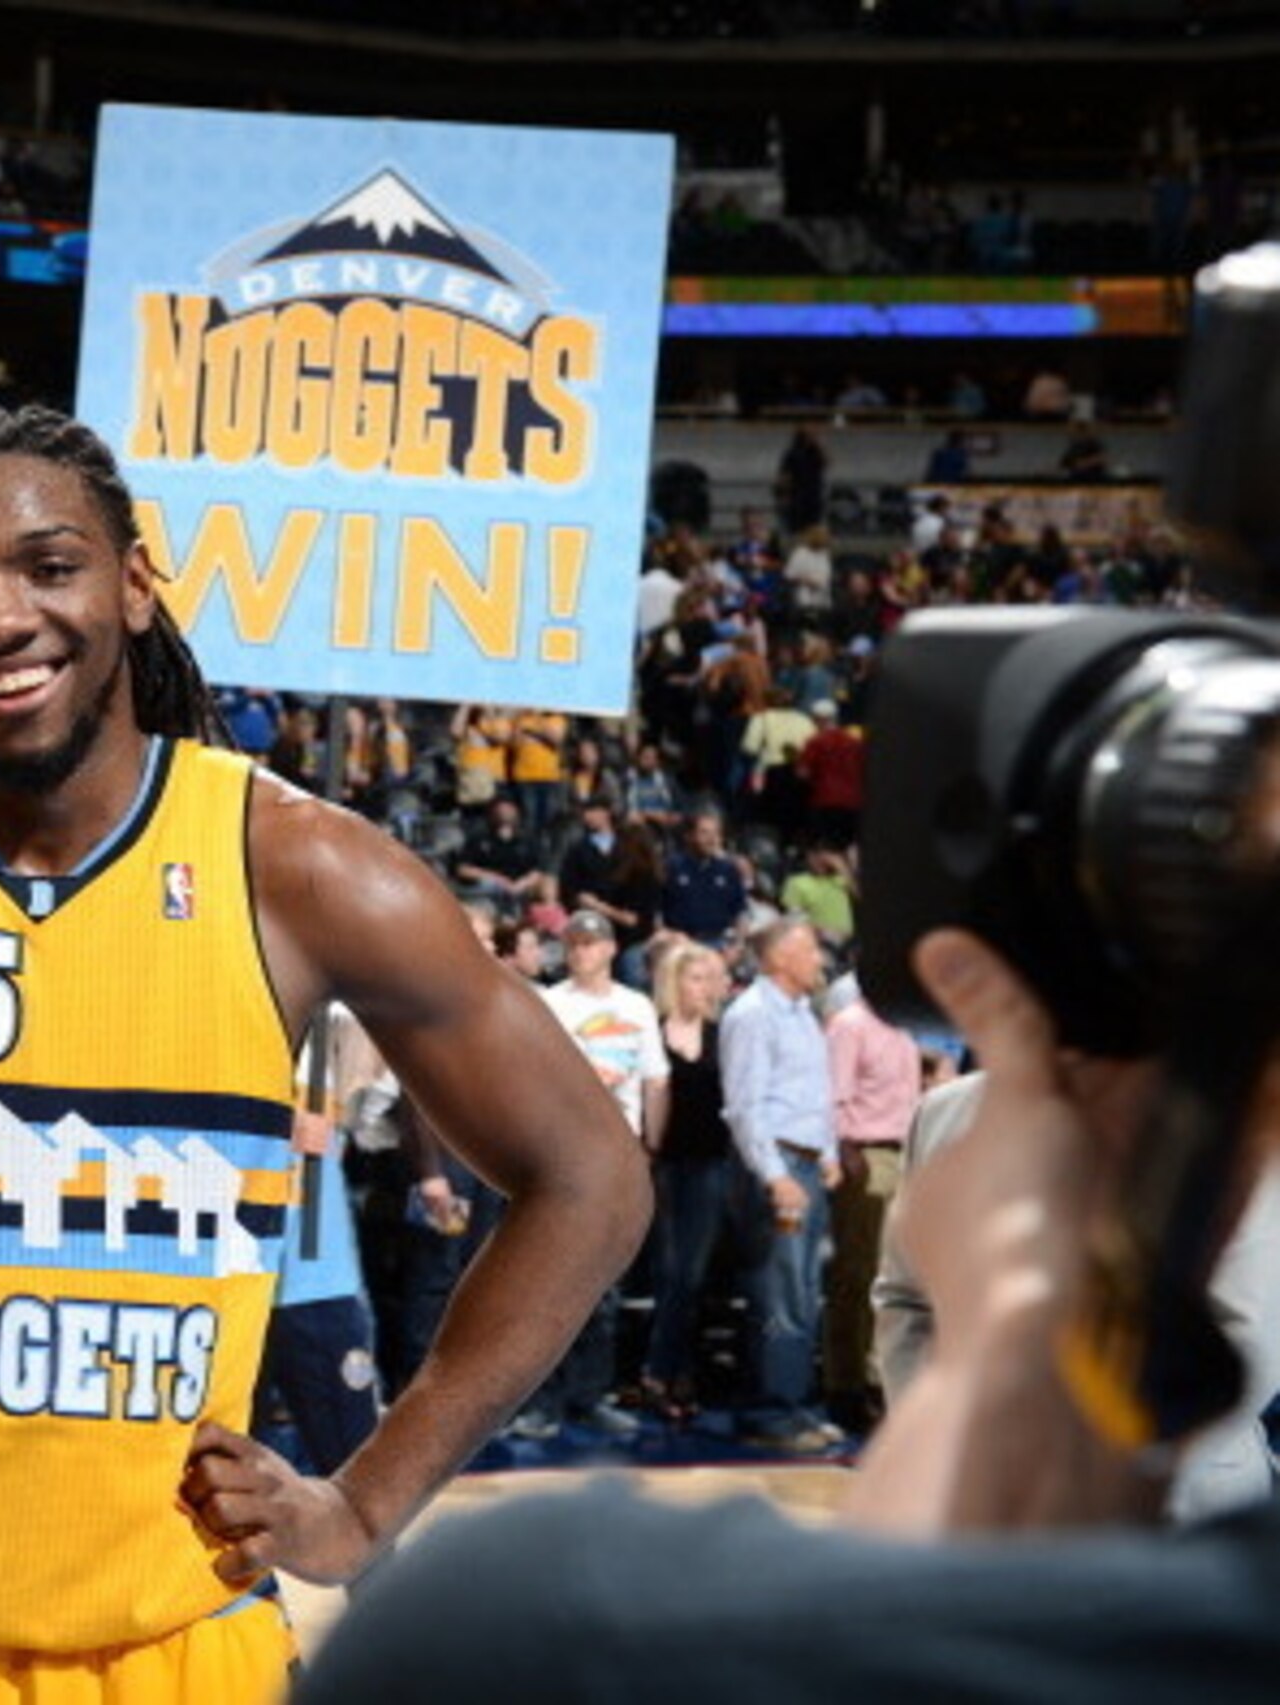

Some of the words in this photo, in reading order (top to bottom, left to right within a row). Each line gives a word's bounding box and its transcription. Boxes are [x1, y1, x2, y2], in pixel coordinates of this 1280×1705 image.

[239, 258, 526, 324] DENVER
[128, 291, 599, 485] NUGGETS
[132, 498, 592, 664] WIN!
